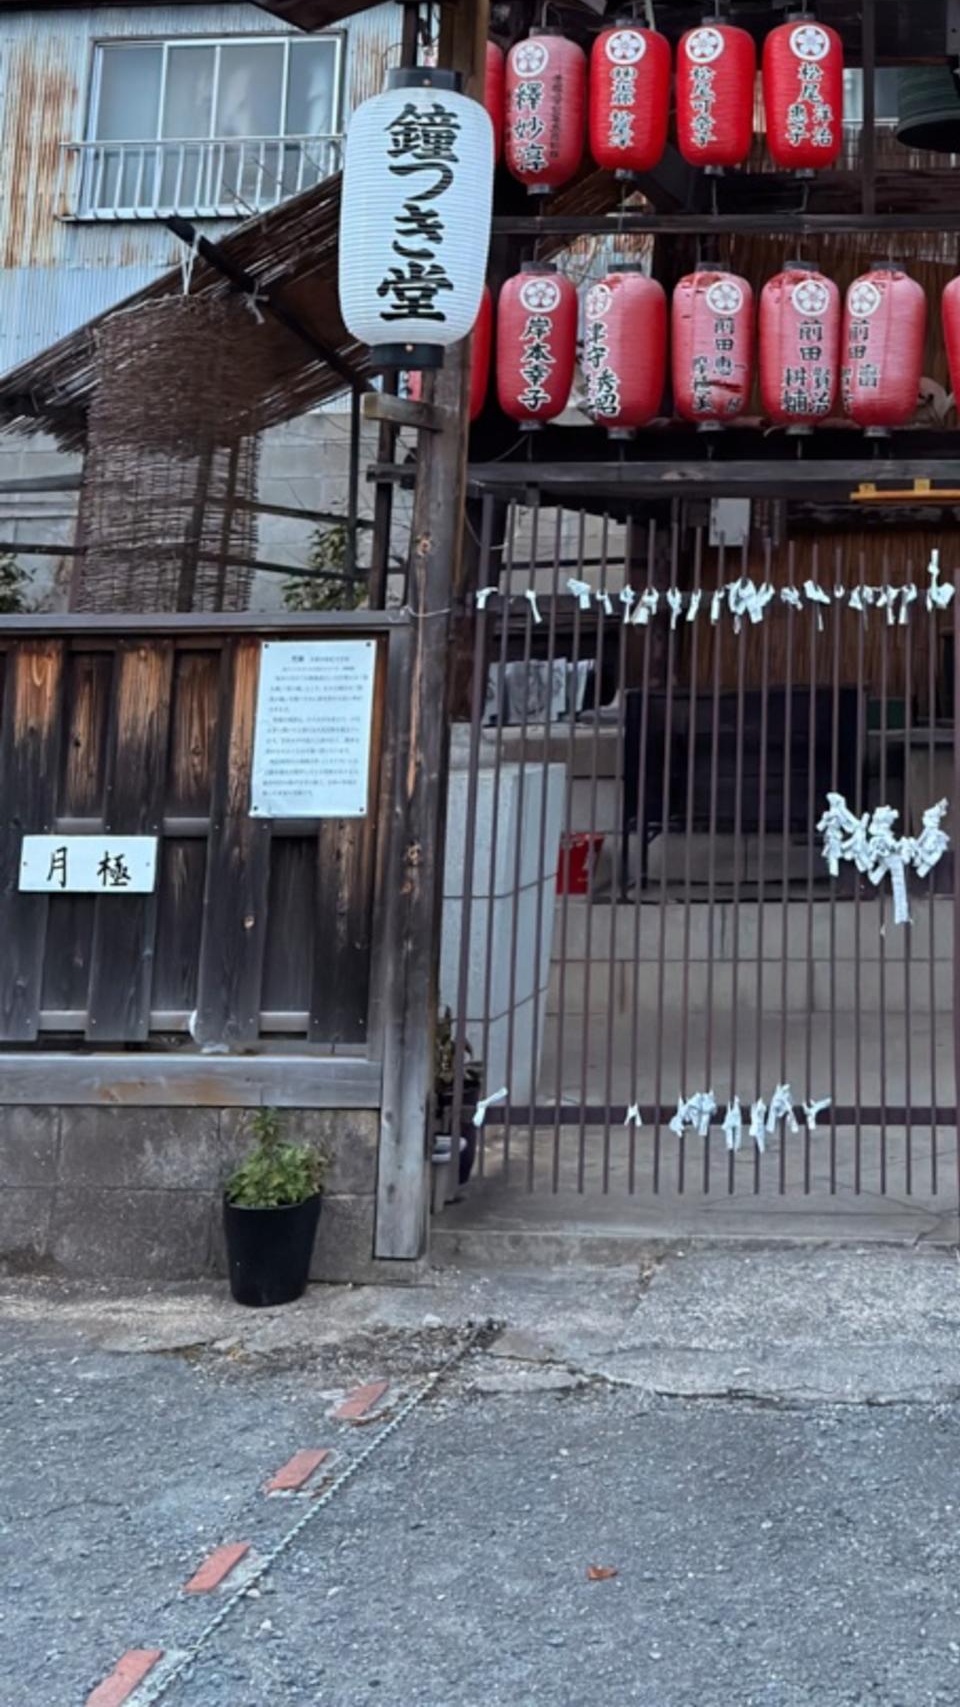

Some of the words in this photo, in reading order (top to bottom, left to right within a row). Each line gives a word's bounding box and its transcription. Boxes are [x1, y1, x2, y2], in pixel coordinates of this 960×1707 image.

[377, 103, 461, 322] 鐘つき堂
[519, 315, 553, 411] 岸本幸子
[47, 846, 131, 888] 月極
